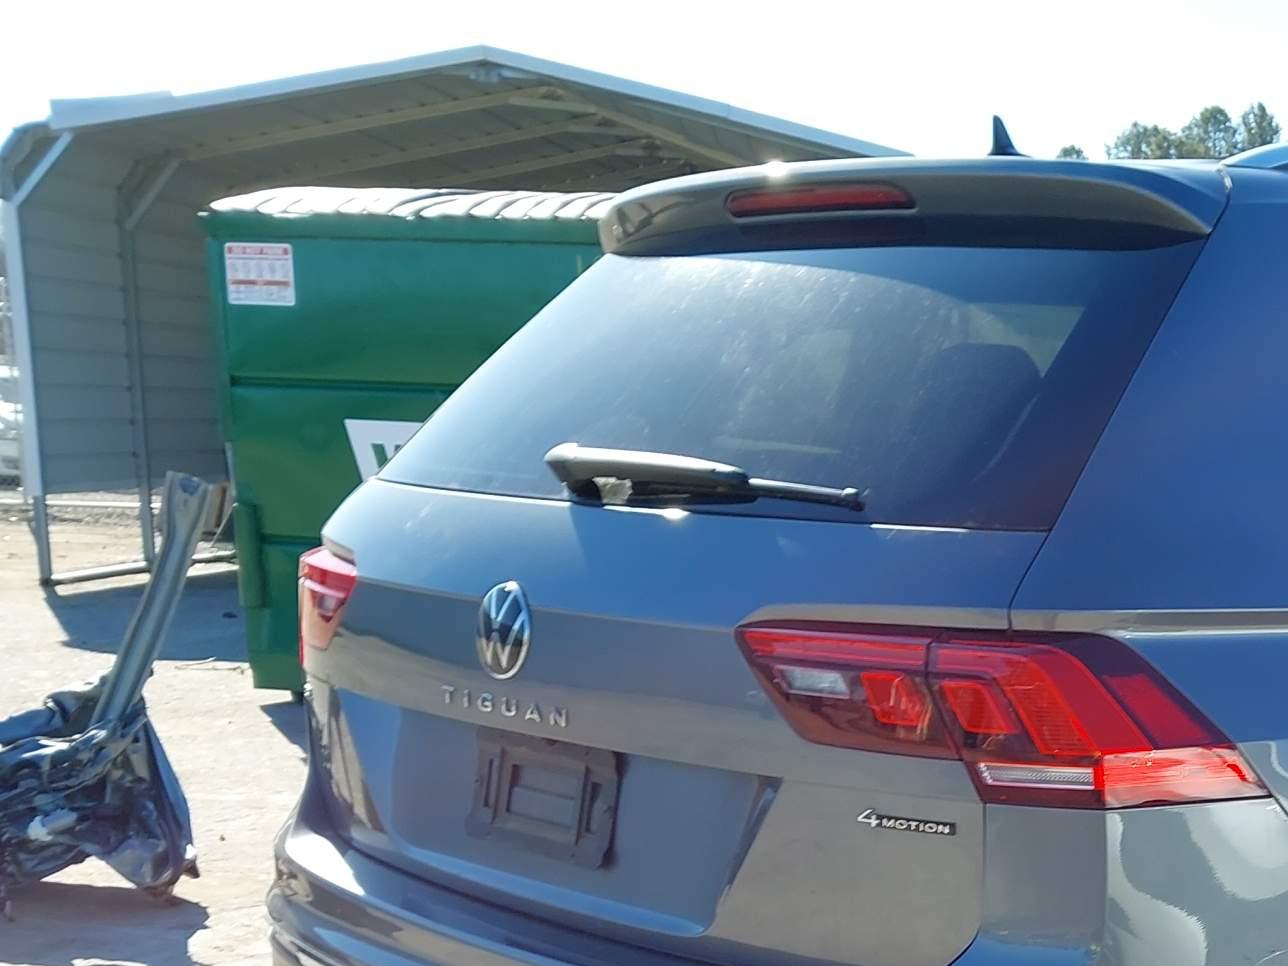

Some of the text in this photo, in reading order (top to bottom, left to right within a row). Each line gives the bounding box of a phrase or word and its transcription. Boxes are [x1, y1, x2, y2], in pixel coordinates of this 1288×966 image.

[478, 580, 530, 680] VW
[440, 684, 569, 728] TIGUAN
[856, 807, 952, 835] 4MOTION
